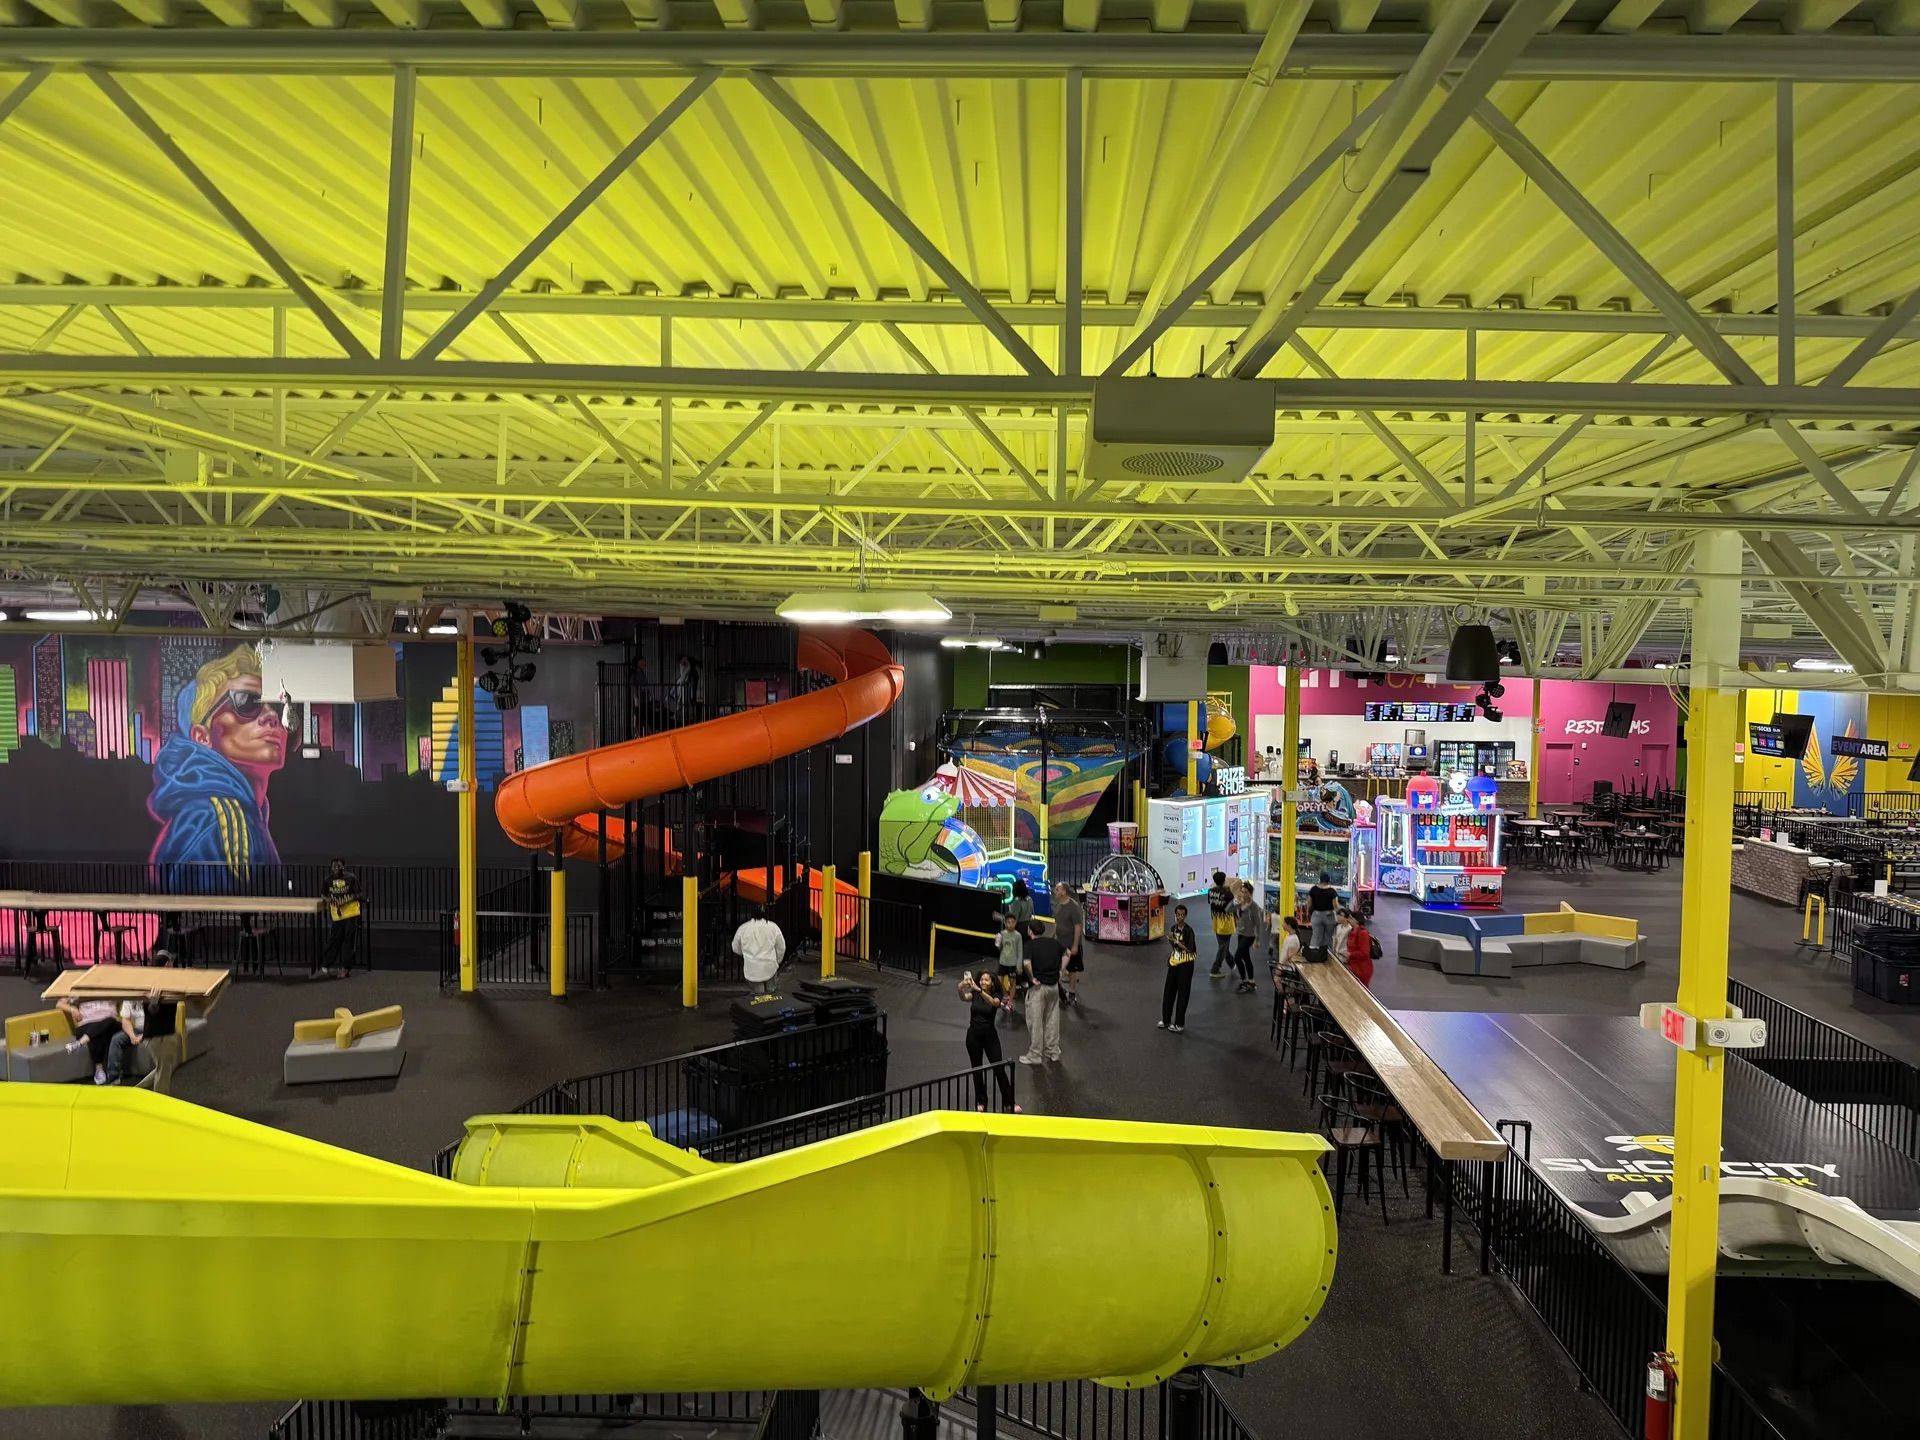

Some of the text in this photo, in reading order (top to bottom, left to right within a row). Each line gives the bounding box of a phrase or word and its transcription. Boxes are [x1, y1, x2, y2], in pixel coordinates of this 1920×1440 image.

[1565, 720, 1650, 734] RESTMS
[1216, 766, 1245, 785] PRIZE
[1225, 780, 1245, 795] HUB
[1296, 802, 1327, 811] OPEYE
